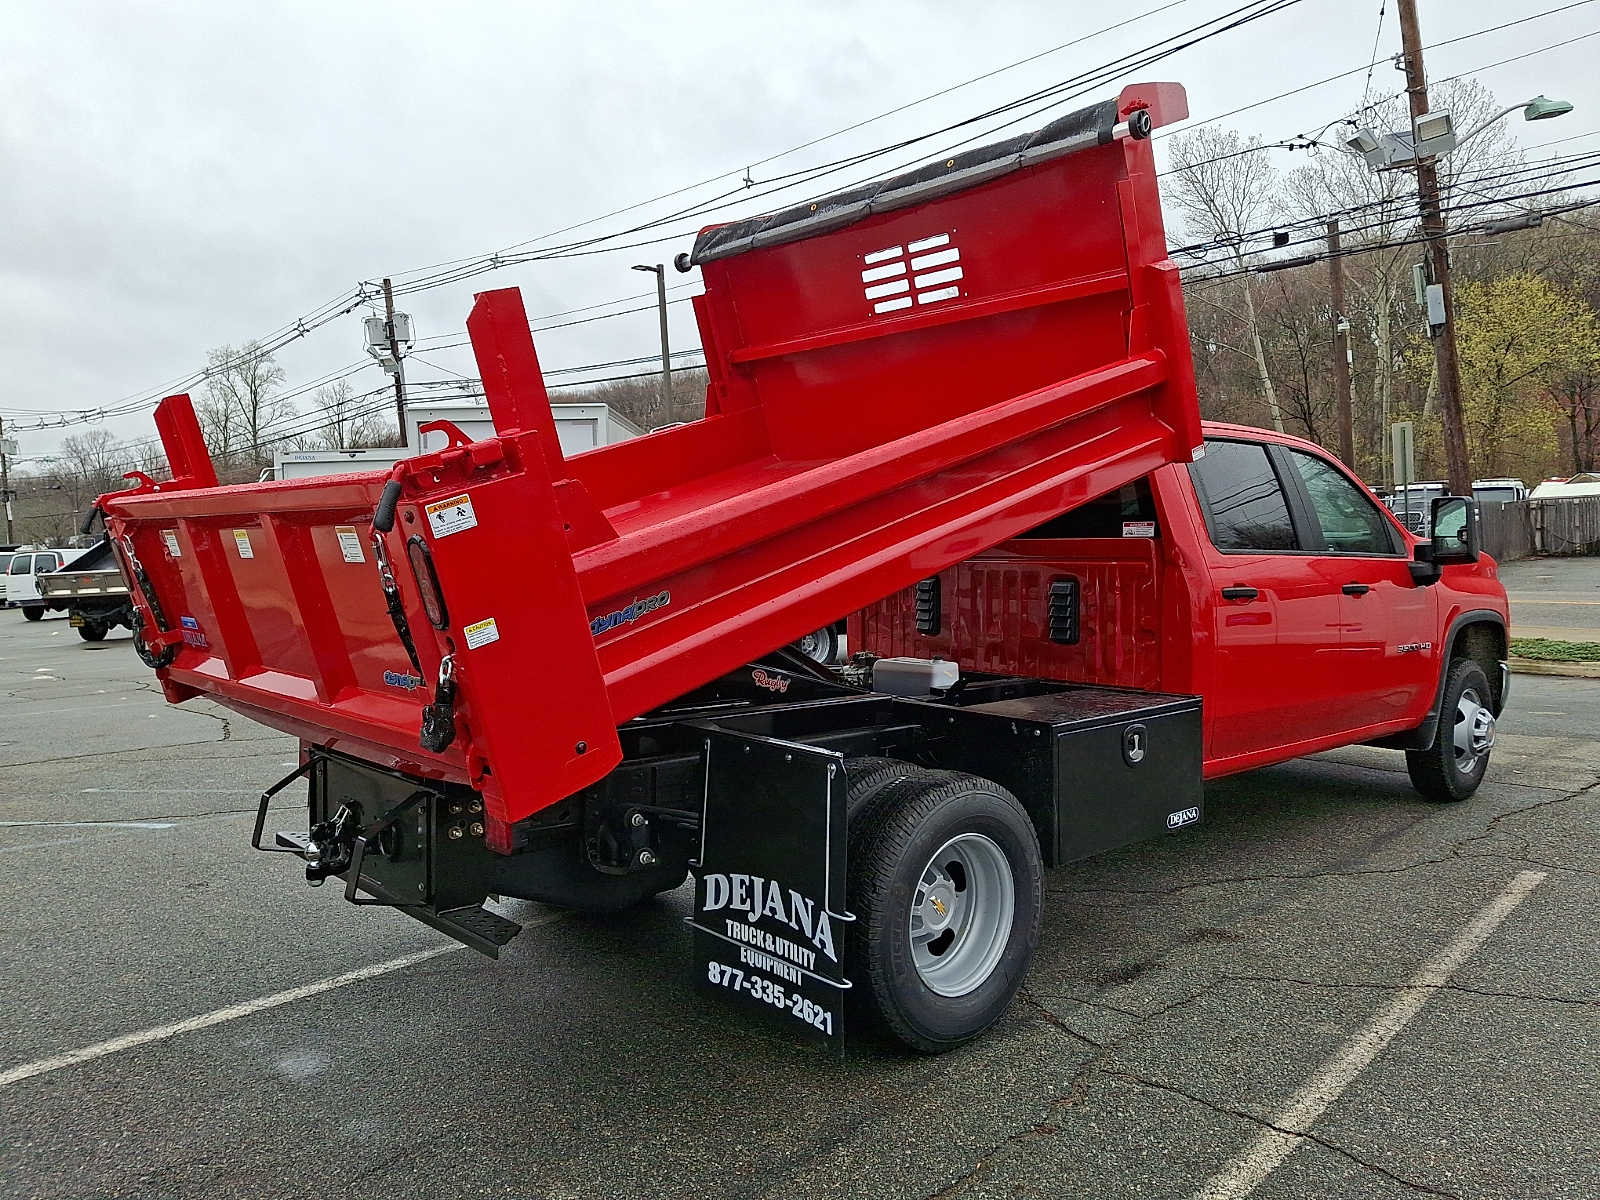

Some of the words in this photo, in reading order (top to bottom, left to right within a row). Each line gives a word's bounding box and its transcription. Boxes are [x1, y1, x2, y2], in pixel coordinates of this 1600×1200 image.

[751, 668, 792, 693] Rugby
[1170, 808, 1197, 826] DEJANA
[702, 873, 838, 963] DEJANA
[740, 946, 803, 986] EQUIPMENT
[707, 961, 834, 1036] 877-335-2621
